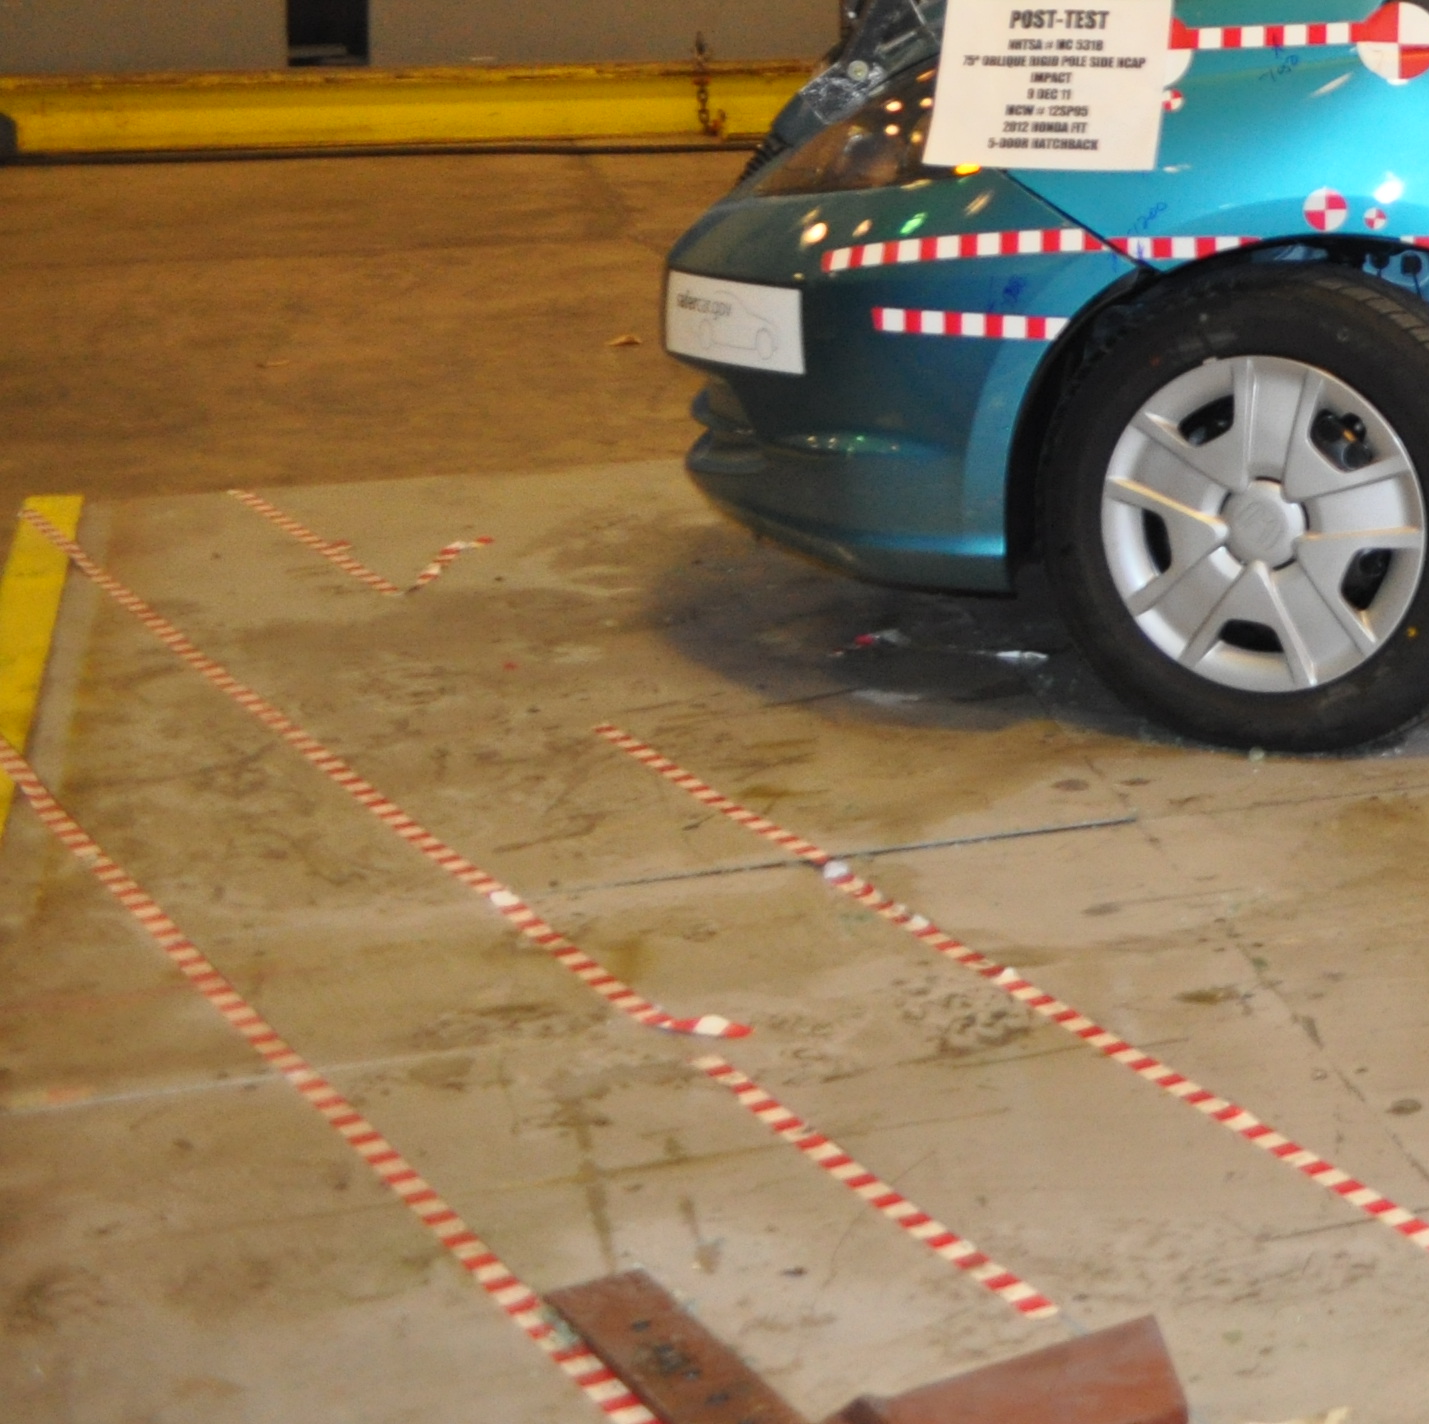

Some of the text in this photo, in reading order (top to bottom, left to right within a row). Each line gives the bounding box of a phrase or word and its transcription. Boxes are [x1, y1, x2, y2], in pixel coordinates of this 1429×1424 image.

[1009, 9, 1110, 30] POST-TEST
[1008, 39, 1043, 51] NHTSA
[982, 55, 1027, 68] OBLIQUE
[1029, 56, 1059, 67] RIGID
[1061, 56, 1088, 68] POLE
[1090, 56, 1114, 68] SIDE
[1116, 57, 1147, 69] NCAP
[1030, 72, 1073, 84] IMPACT
[1037, 88, 1059, 100] DEC
[1003, 121, 1088, 134] 2012 HONDA FIT
[987, 138, 1099, 151] 5-DOOR HATCHBACK
